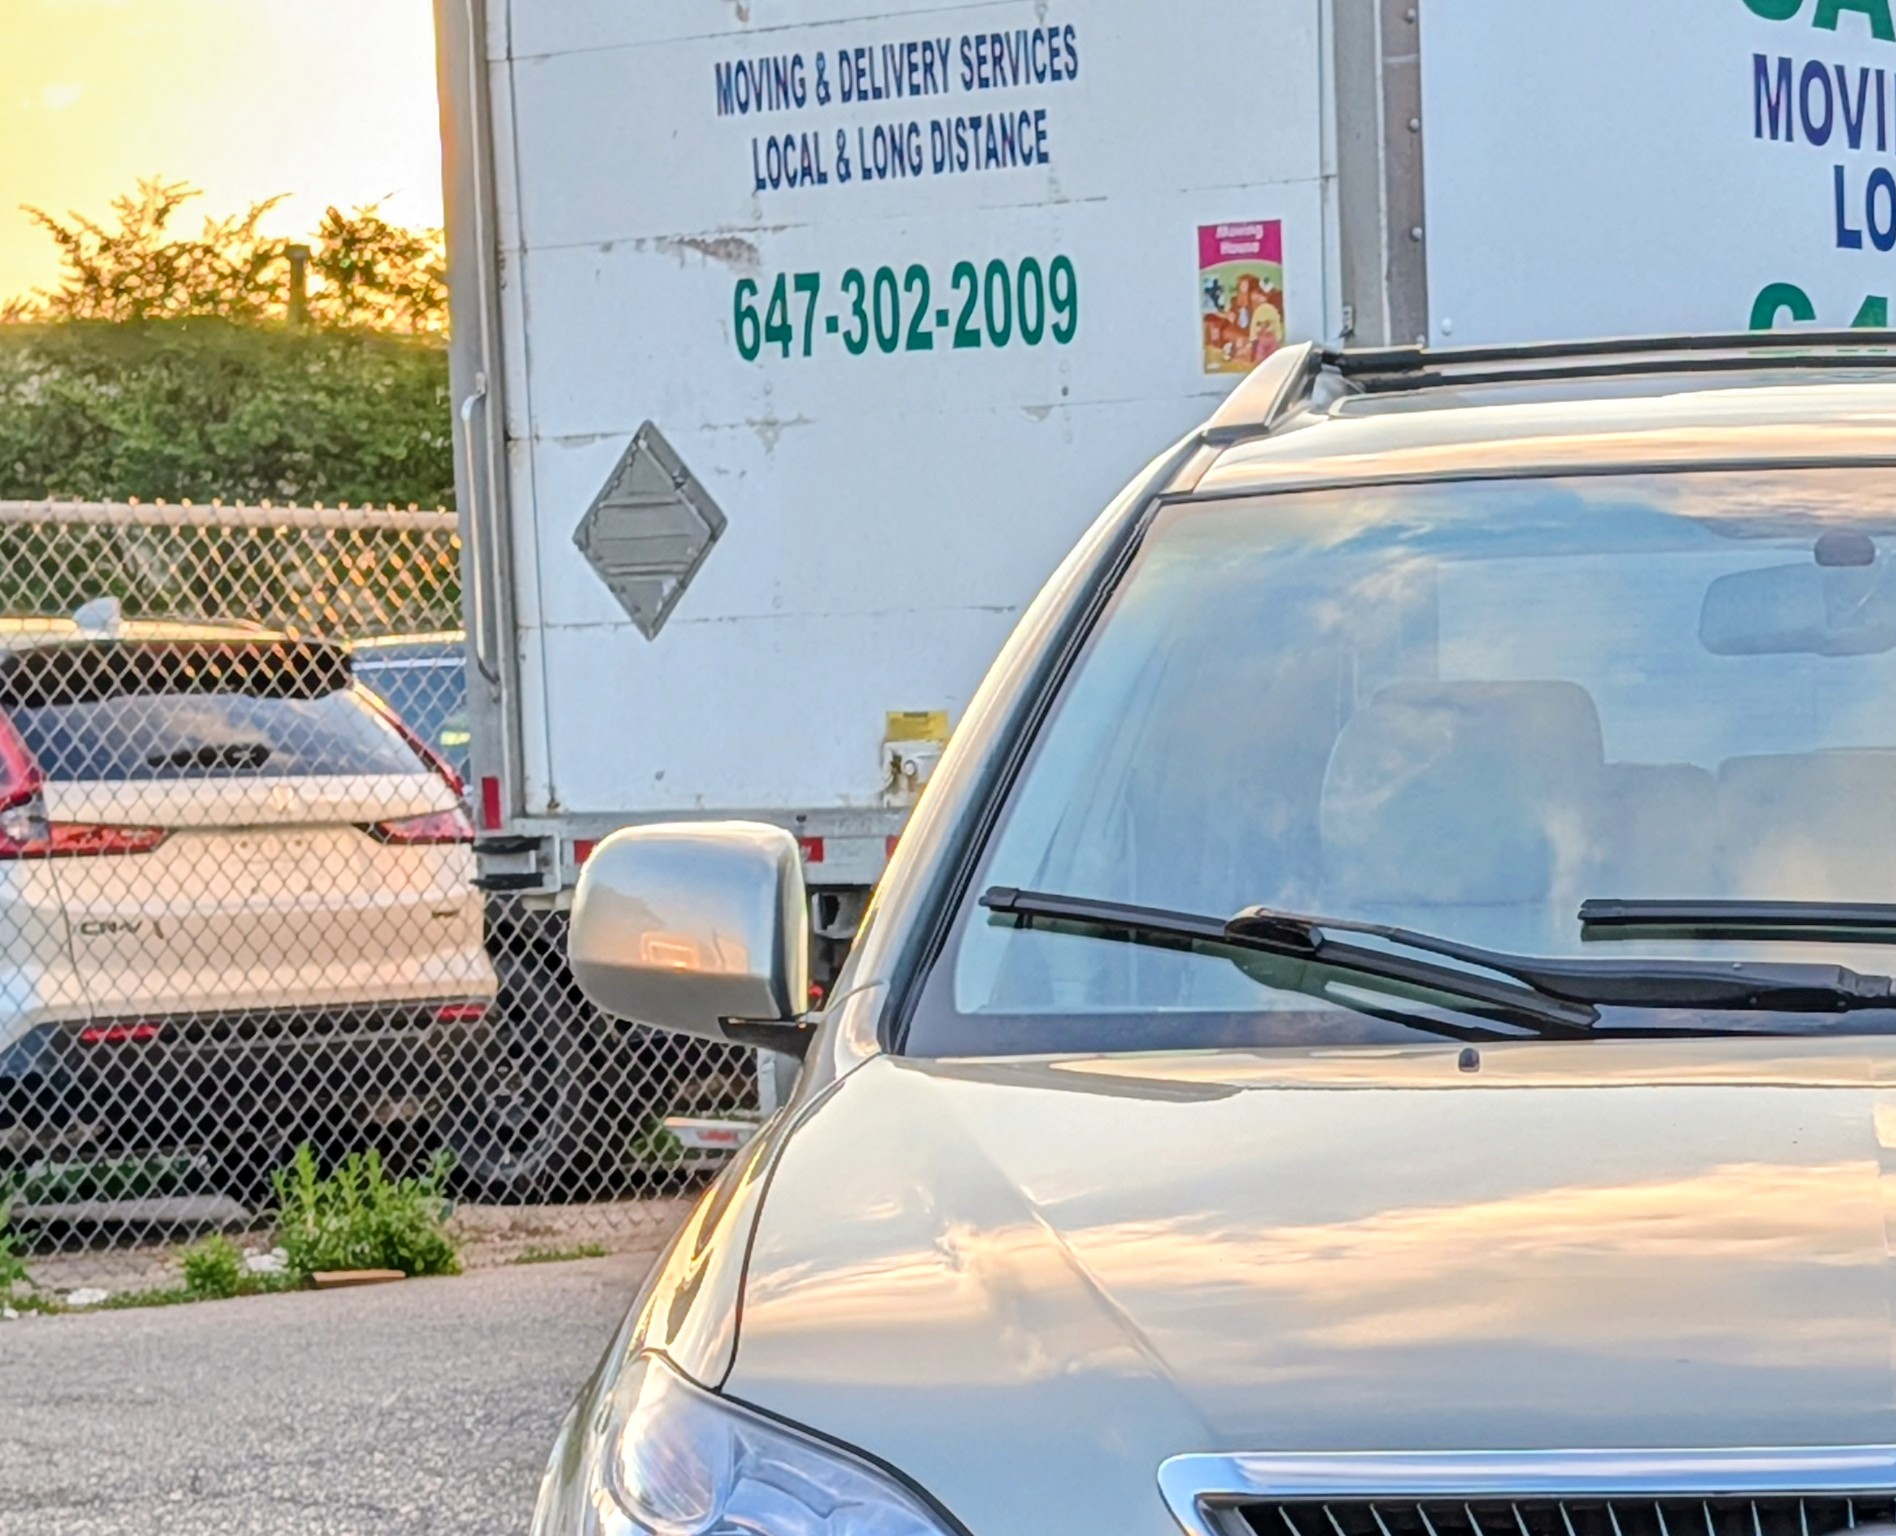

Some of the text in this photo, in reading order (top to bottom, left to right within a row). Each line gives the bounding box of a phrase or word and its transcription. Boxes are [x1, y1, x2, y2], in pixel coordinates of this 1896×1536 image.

[714, 23, 1080, 117] MOVING & DELIVERY SERVICES
[751, 108, 1051, 192] LOCAL & LONG DISTANCE
[733, 254, 1078, 363] 647-302-2009
